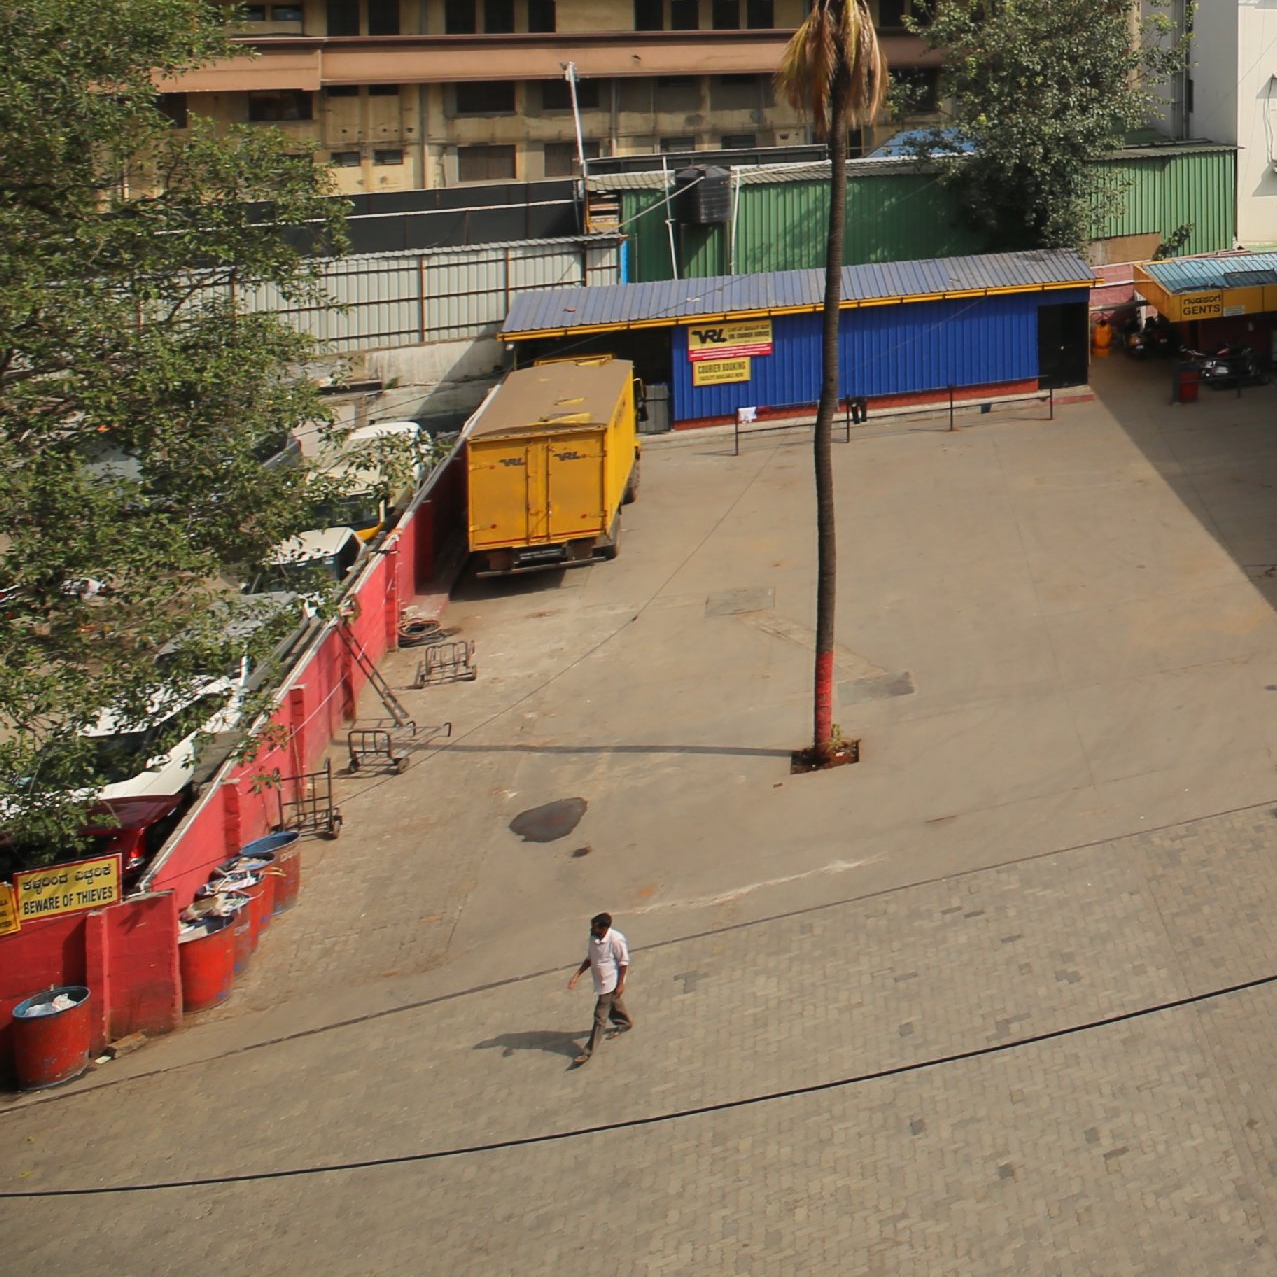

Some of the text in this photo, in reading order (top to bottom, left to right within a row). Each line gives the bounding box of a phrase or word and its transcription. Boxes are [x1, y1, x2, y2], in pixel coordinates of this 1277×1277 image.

[1182, 303, 1221, 316] GENTS
[691, 328, 727, 344] VRL
[23, 896, 60, 915] BEWARE
[62, 893, 74, 907] OF
[76, 885, 113, 905] THIEVES
